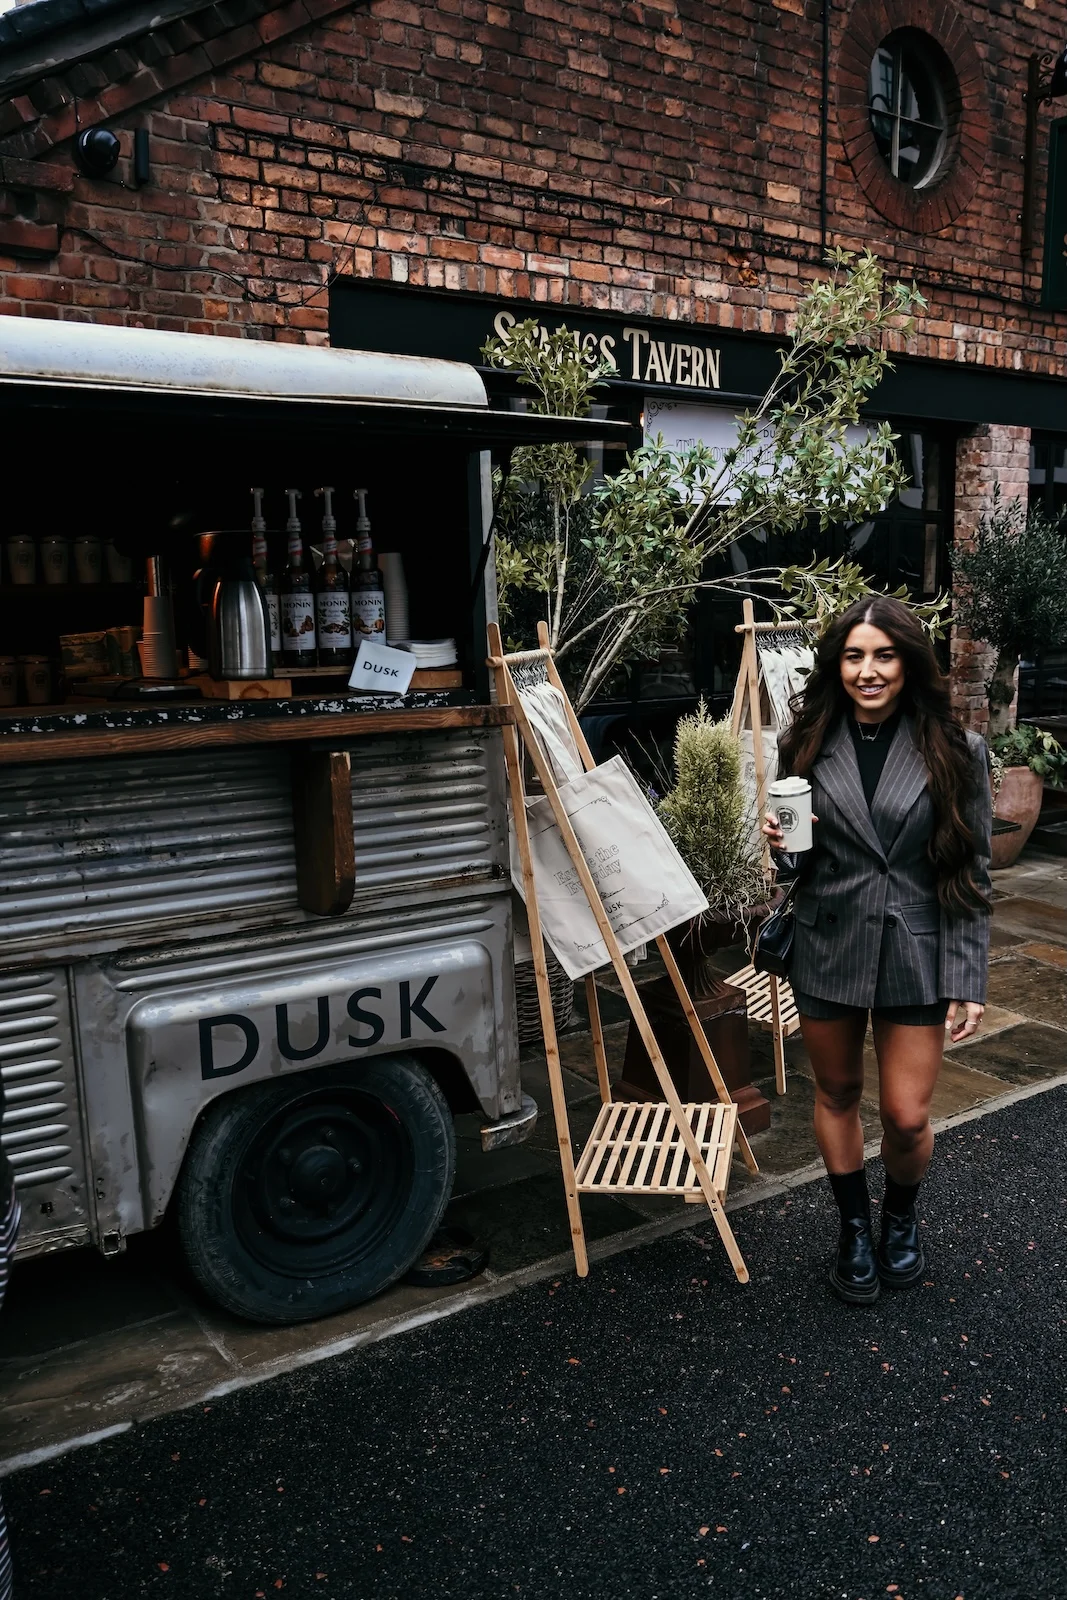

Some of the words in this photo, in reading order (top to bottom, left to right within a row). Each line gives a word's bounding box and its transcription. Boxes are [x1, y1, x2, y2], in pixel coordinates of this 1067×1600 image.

[622, 327, 721, 389] TAVERN
[283, 601, 311, 609] MONIN
[320, 599, 347, 607] MONIN
[362, 660, 400, 678] DUSK
[553, 856, 597, 886] Esce
[594, 843, 620, 864] the
[565, 858, 622, 896] Evyday
[605, 900, 624, 914] USK
[197, 975, 447, 1081] DUSK
